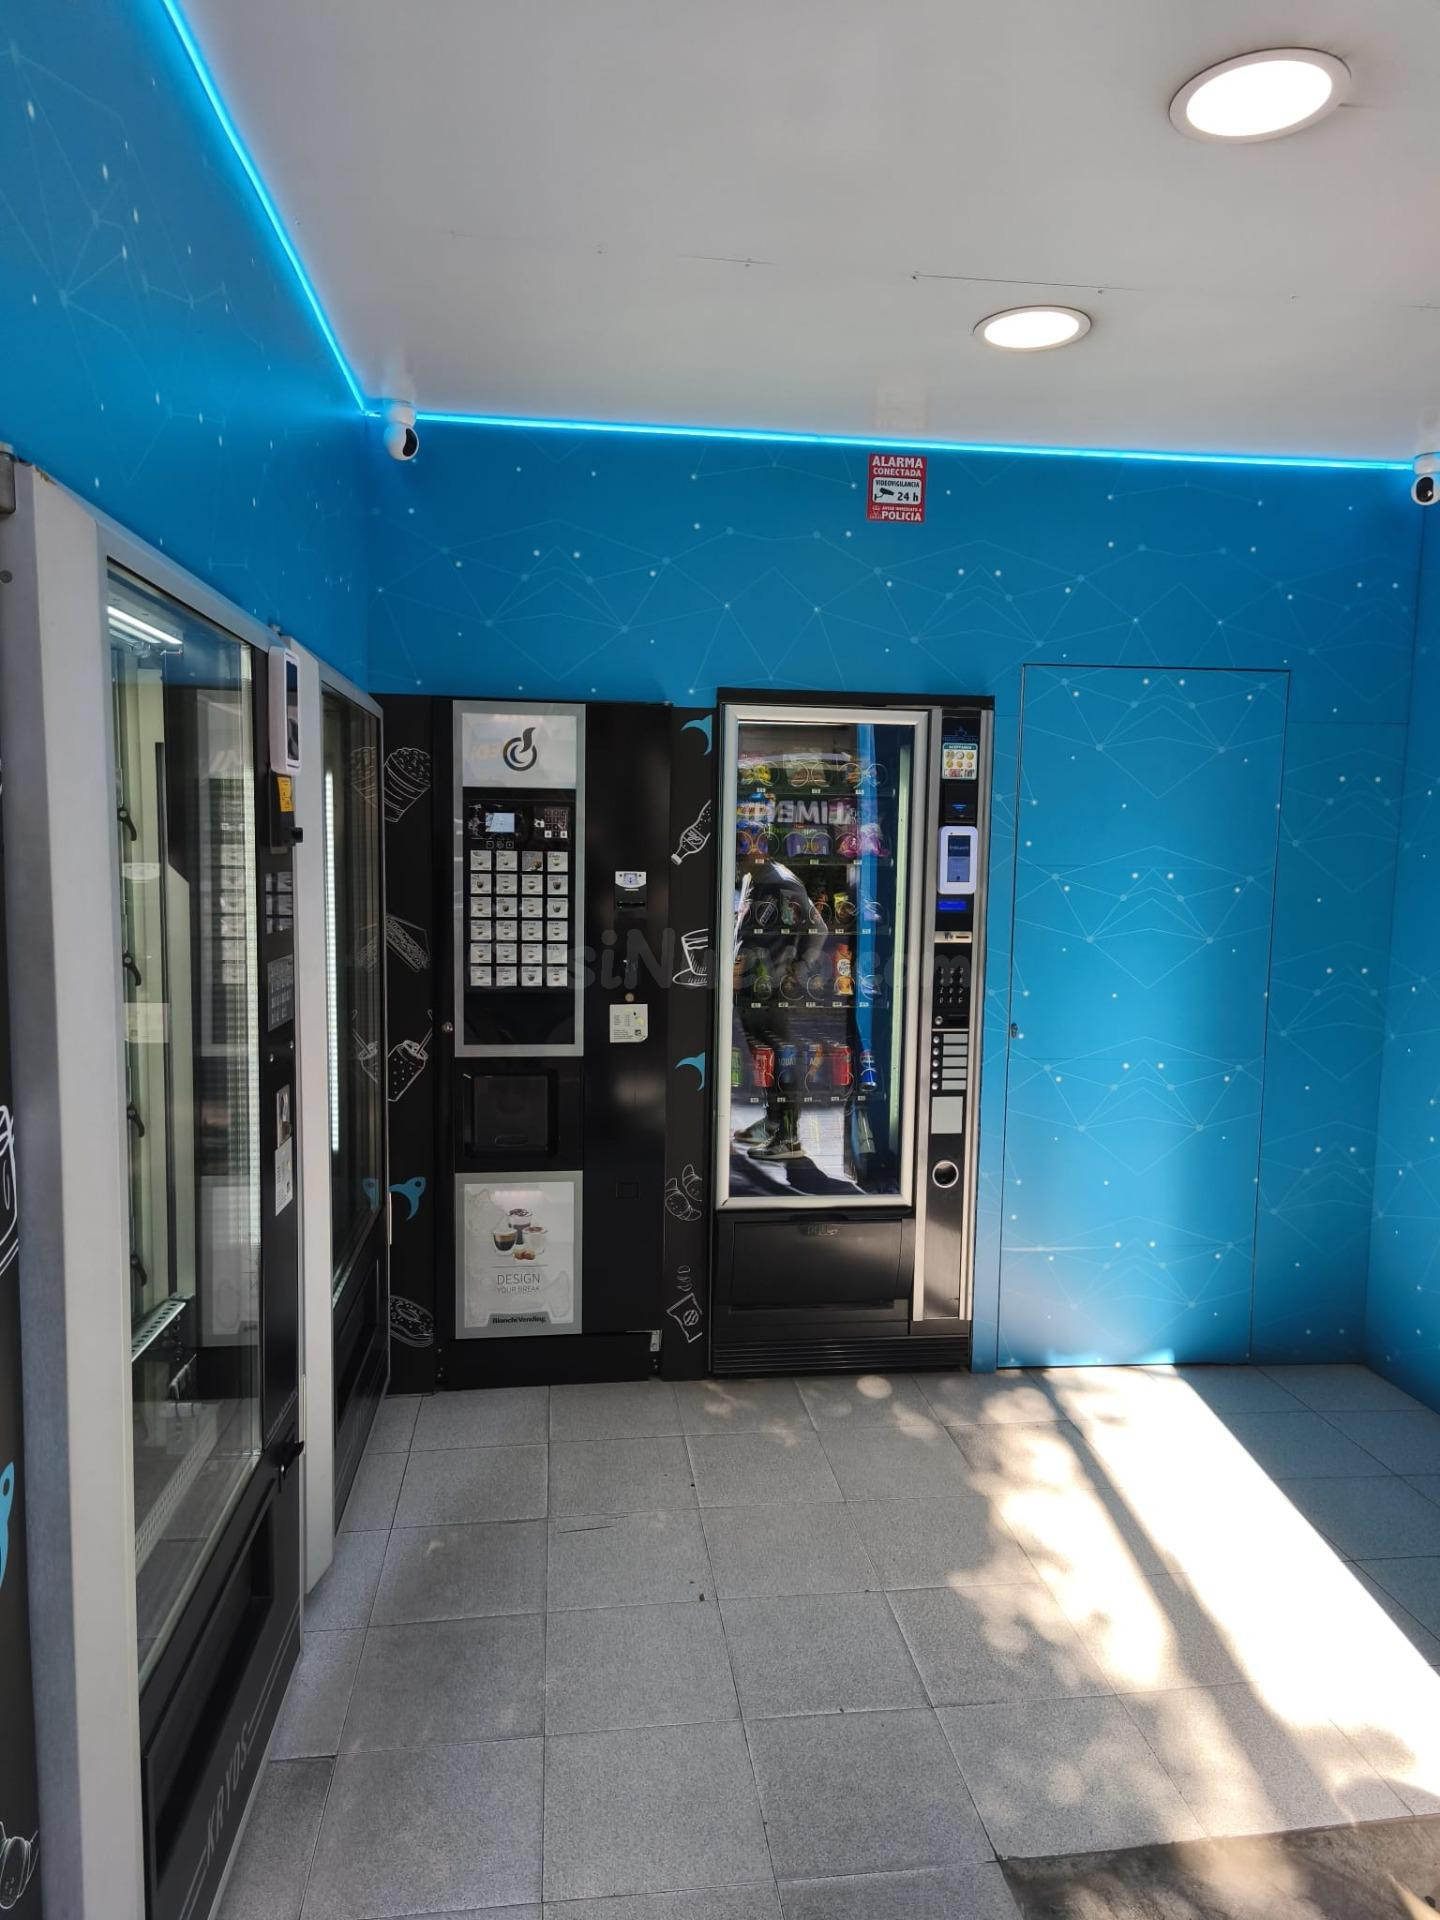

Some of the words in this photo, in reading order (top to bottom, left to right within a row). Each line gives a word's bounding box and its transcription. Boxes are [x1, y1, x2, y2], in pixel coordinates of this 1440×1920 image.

[872, 456, 923, 469] ALARMA
[873, 468, 921, 477] CONECTADA
[875, 480, 919, 488] VIDEOVIGILANCIA
[897, 492, 909, 501] 24
[912, 492, 919, 502] h
[881, 511, 922, 521] POLICIA
[497, 1273, 540, 1285] DESIGN
